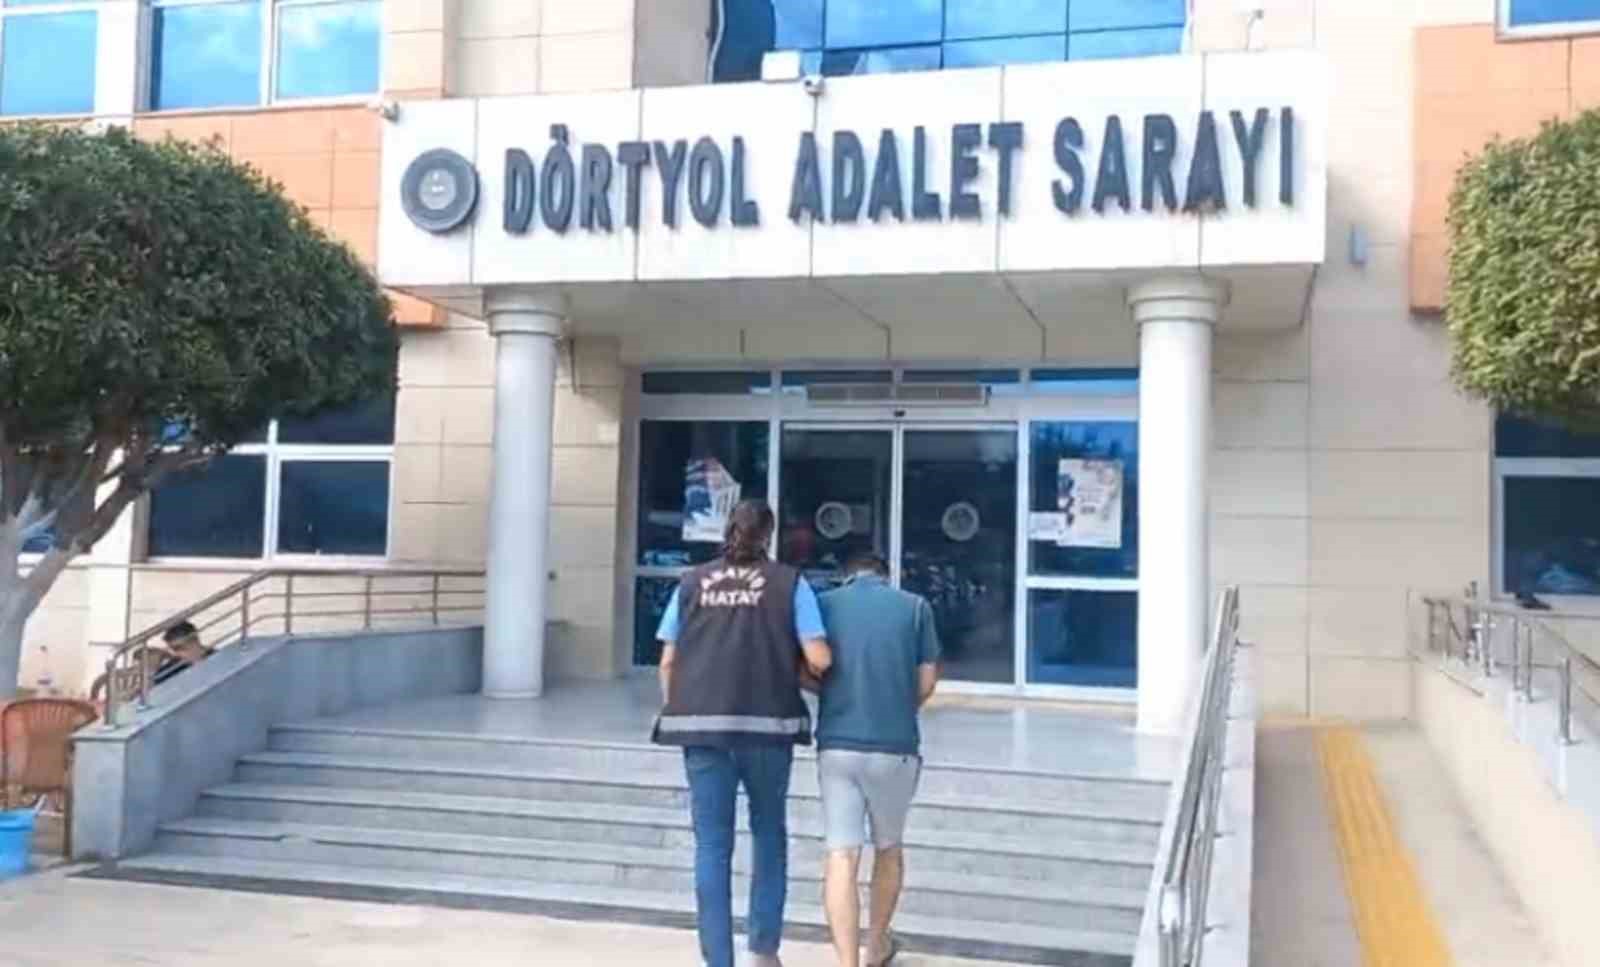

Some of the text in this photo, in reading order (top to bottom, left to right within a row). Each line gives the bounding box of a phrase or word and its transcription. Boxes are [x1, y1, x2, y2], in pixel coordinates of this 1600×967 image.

[503, 106, 1295, 234] DÖRTYOL ADALET SARAYI
[700, 590, 764, 607] HATAY
